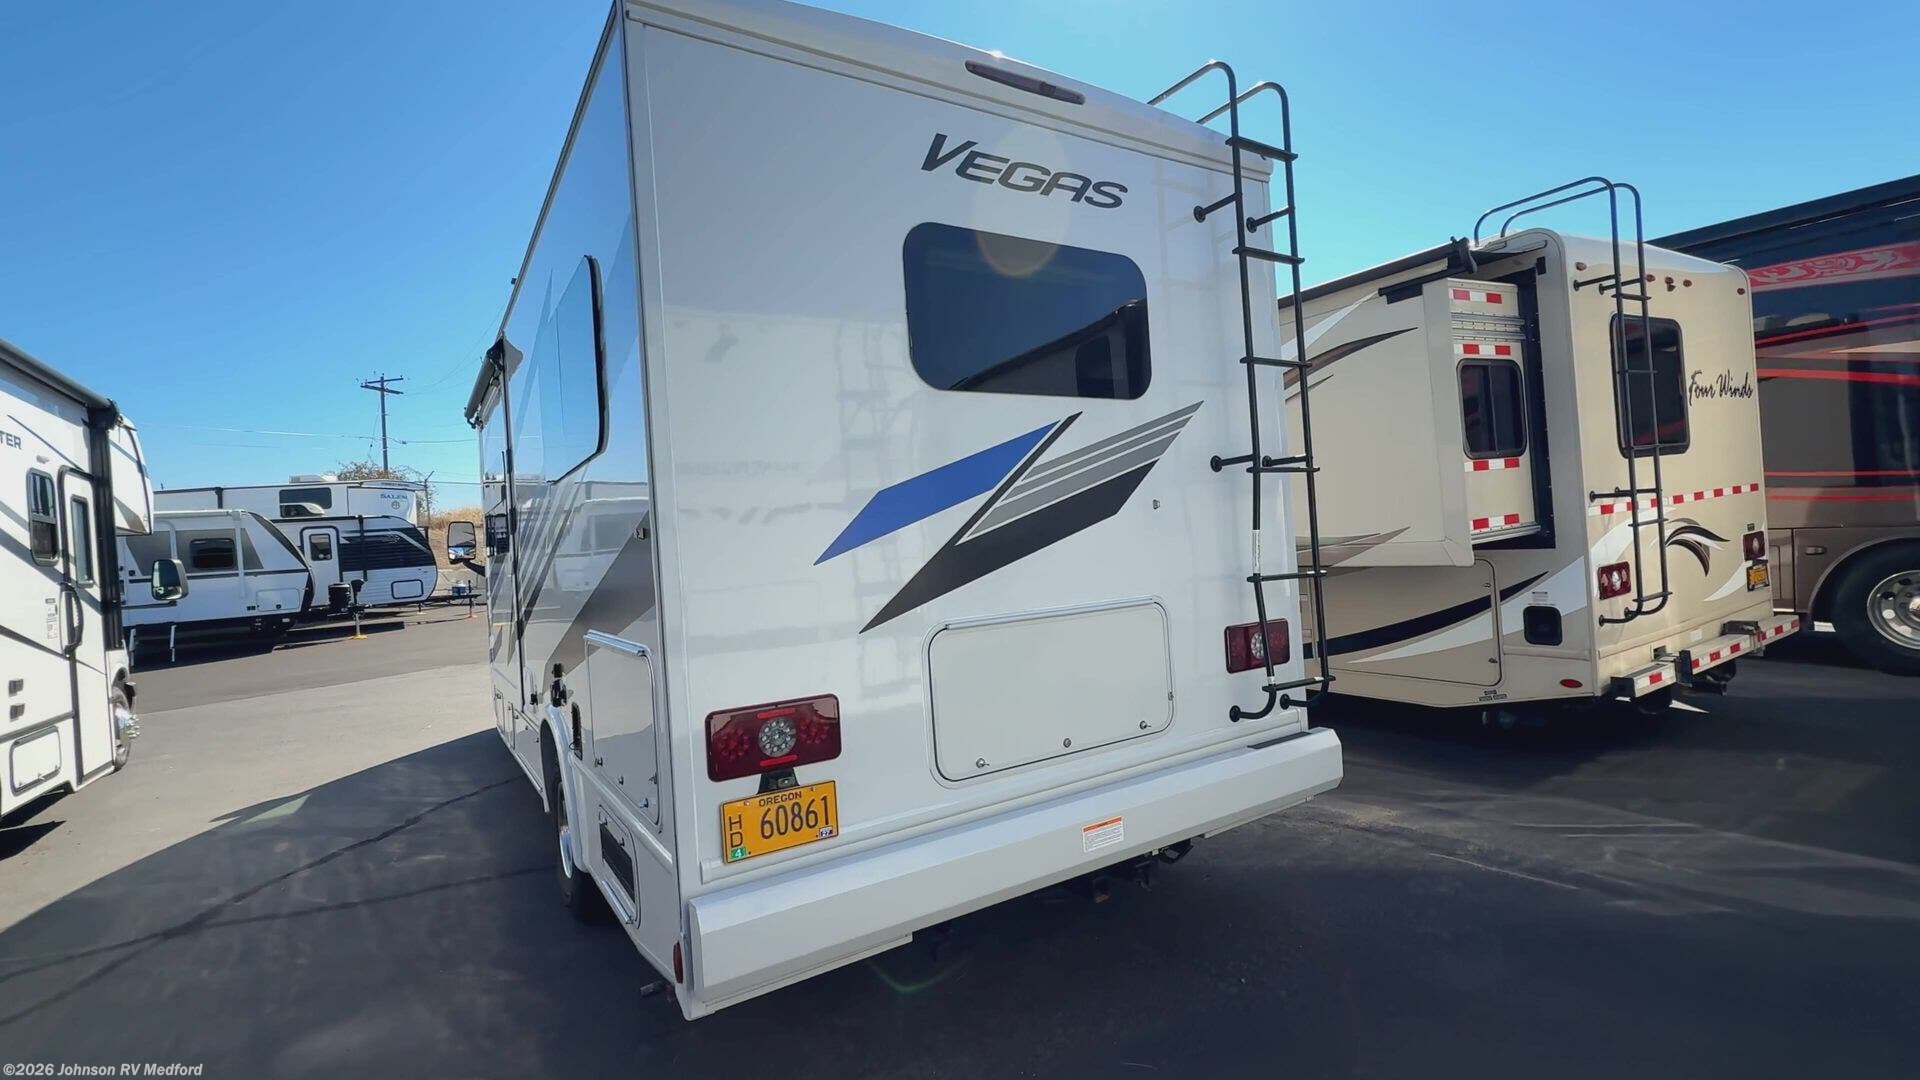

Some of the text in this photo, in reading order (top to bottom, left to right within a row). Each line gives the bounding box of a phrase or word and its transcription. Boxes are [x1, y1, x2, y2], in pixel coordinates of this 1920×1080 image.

[921, 133, 1128, 208] VEGAS
[1689, 369, 1753, 406] Four Winds
[758, 791, 802, 807] OREGON
[760, 795, 829, 840] 60861
